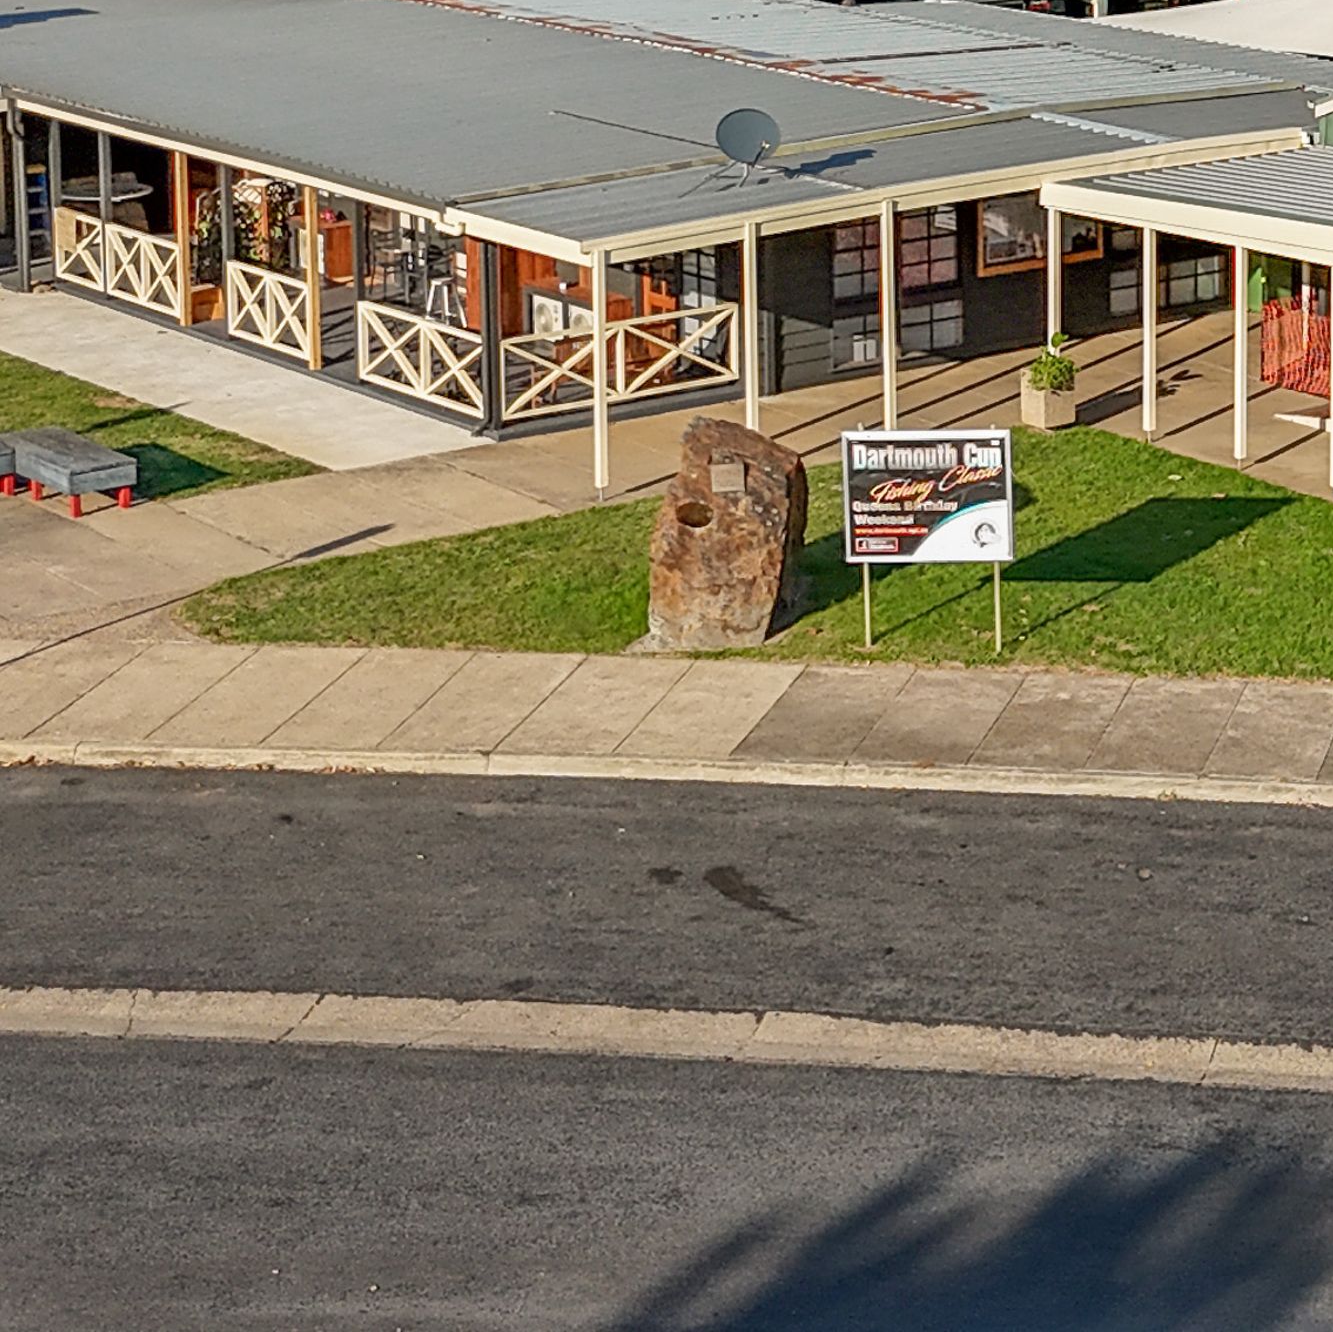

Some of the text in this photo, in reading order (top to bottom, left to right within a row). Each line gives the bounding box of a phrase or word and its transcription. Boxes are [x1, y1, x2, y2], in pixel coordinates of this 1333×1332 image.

[853, 442, 1002, 470] Dartmouth Cup
[870, 465, 1003, 504] Fishing Classic
